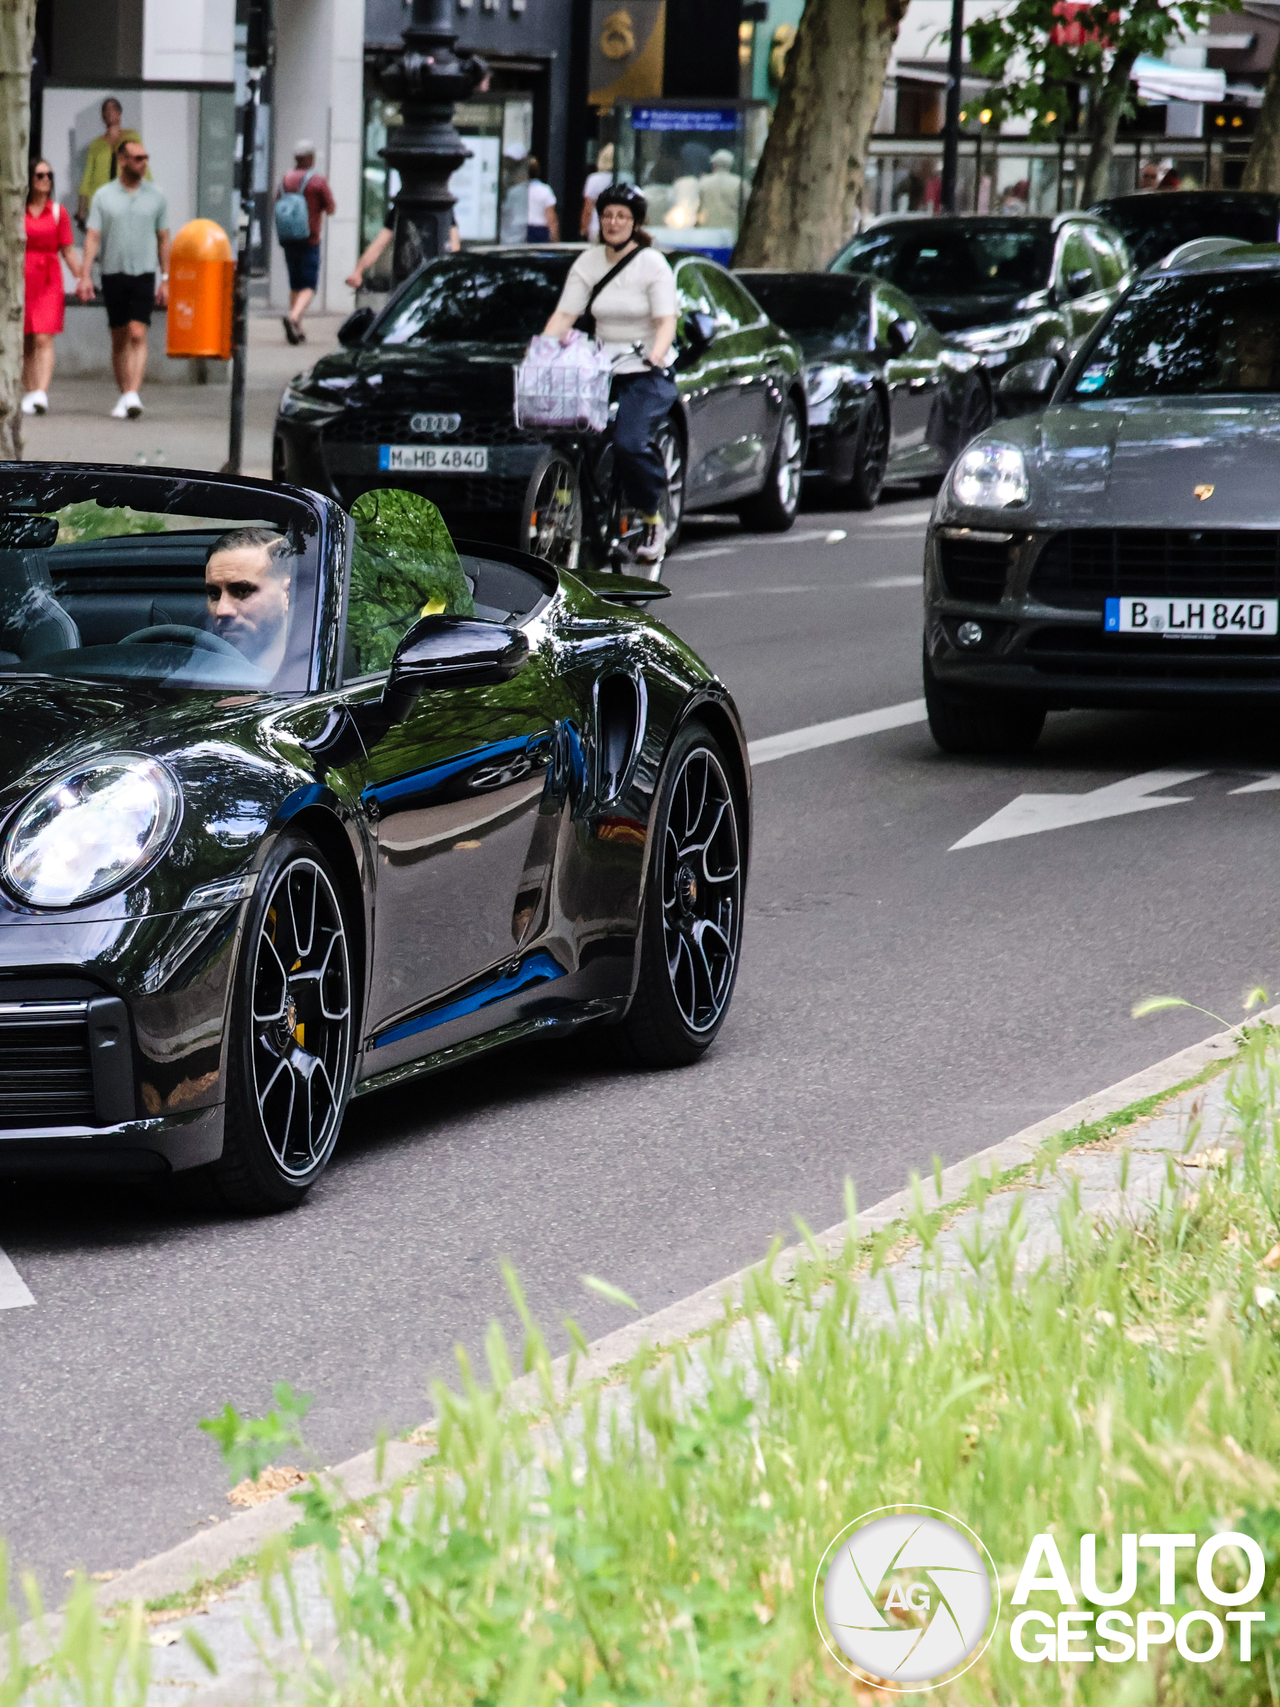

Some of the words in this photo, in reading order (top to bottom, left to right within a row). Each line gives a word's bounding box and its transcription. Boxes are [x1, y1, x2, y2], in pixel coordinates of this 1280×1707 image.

[391, 451, 402, 466] M
[414, 451, 437, 467] HB
[441, 451, 485, 468] 4840
[1131, 602, 1148, 628] B
[1168, 603, 1205, 629] LH
[1212, 604, 1266, 630] 840
